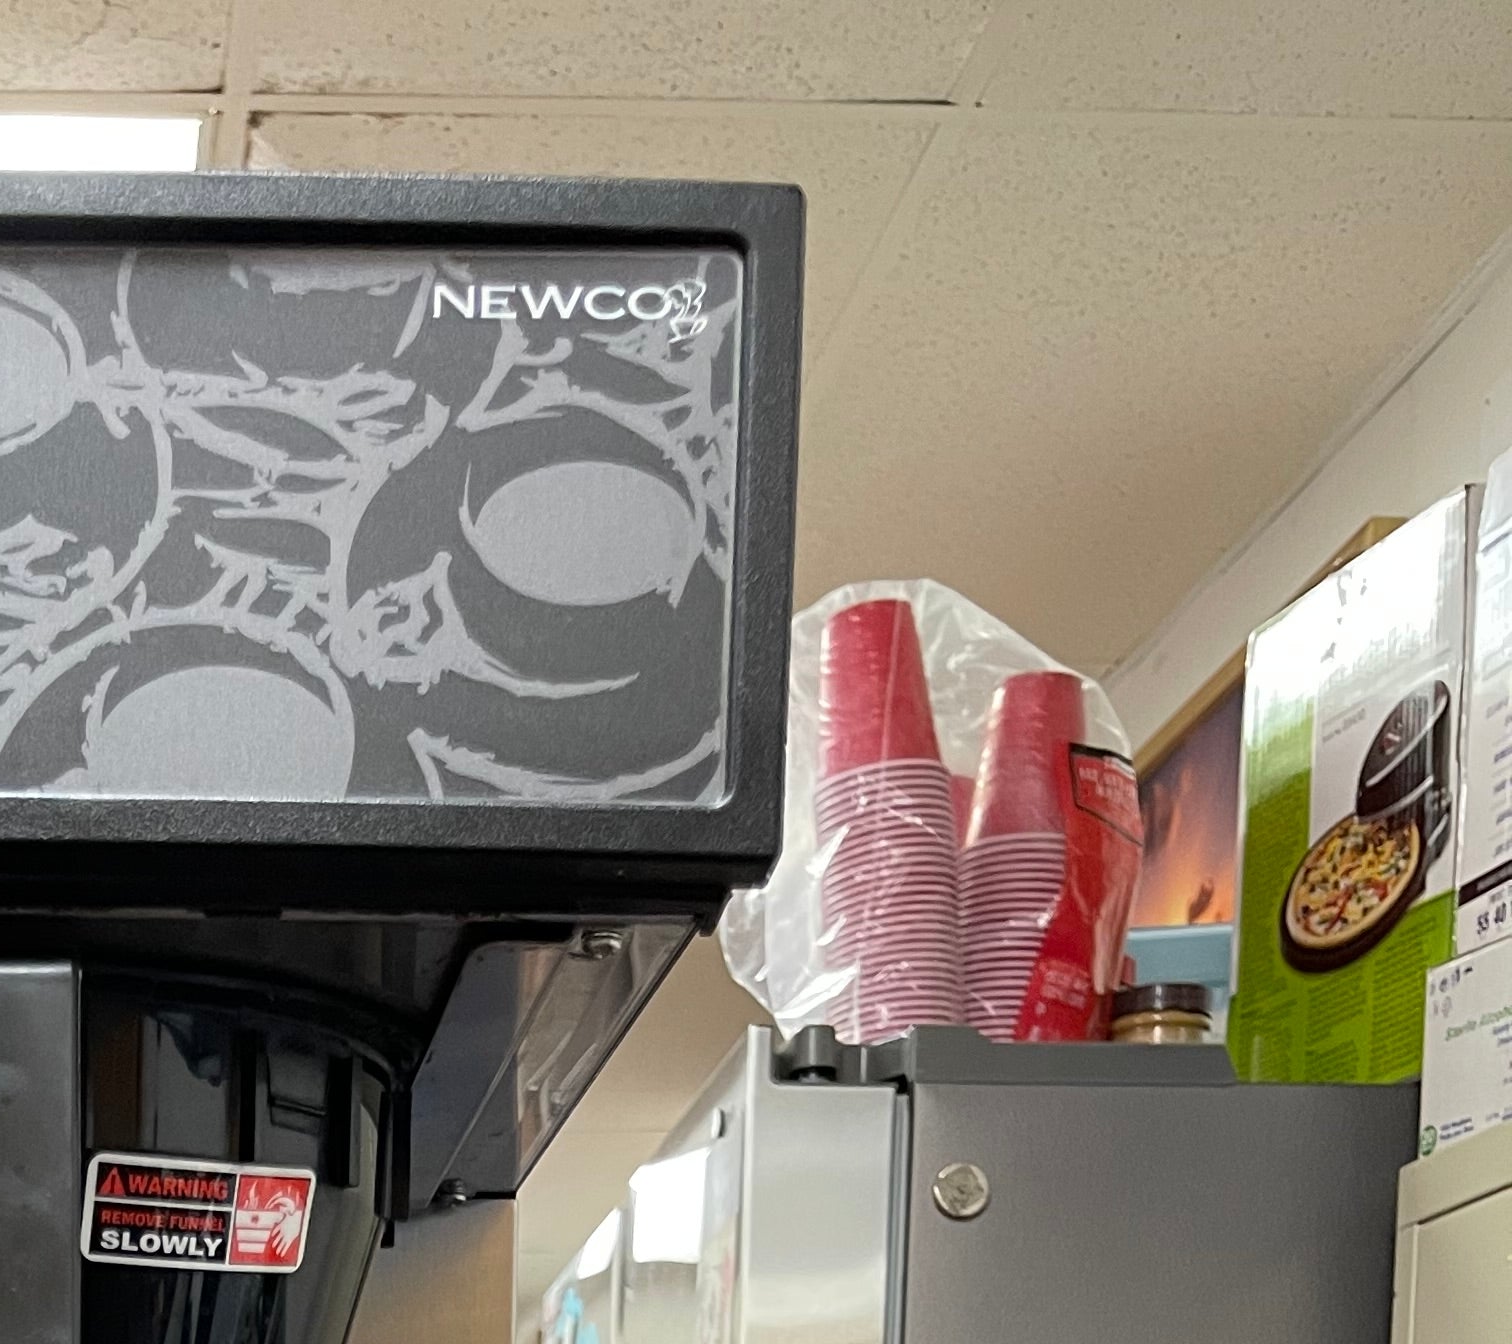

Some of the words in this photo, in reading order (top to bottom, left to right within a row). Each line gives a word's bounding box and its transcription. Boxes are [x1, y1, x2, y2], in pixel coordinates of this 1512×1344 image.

[433, 284, 672, 320] NEWCO
[128, 1174, 229, 1200] WARNING
[101, 1210, 165, 1229] REMOVE
[100, 1230, 223, 1257] SLOWLY
